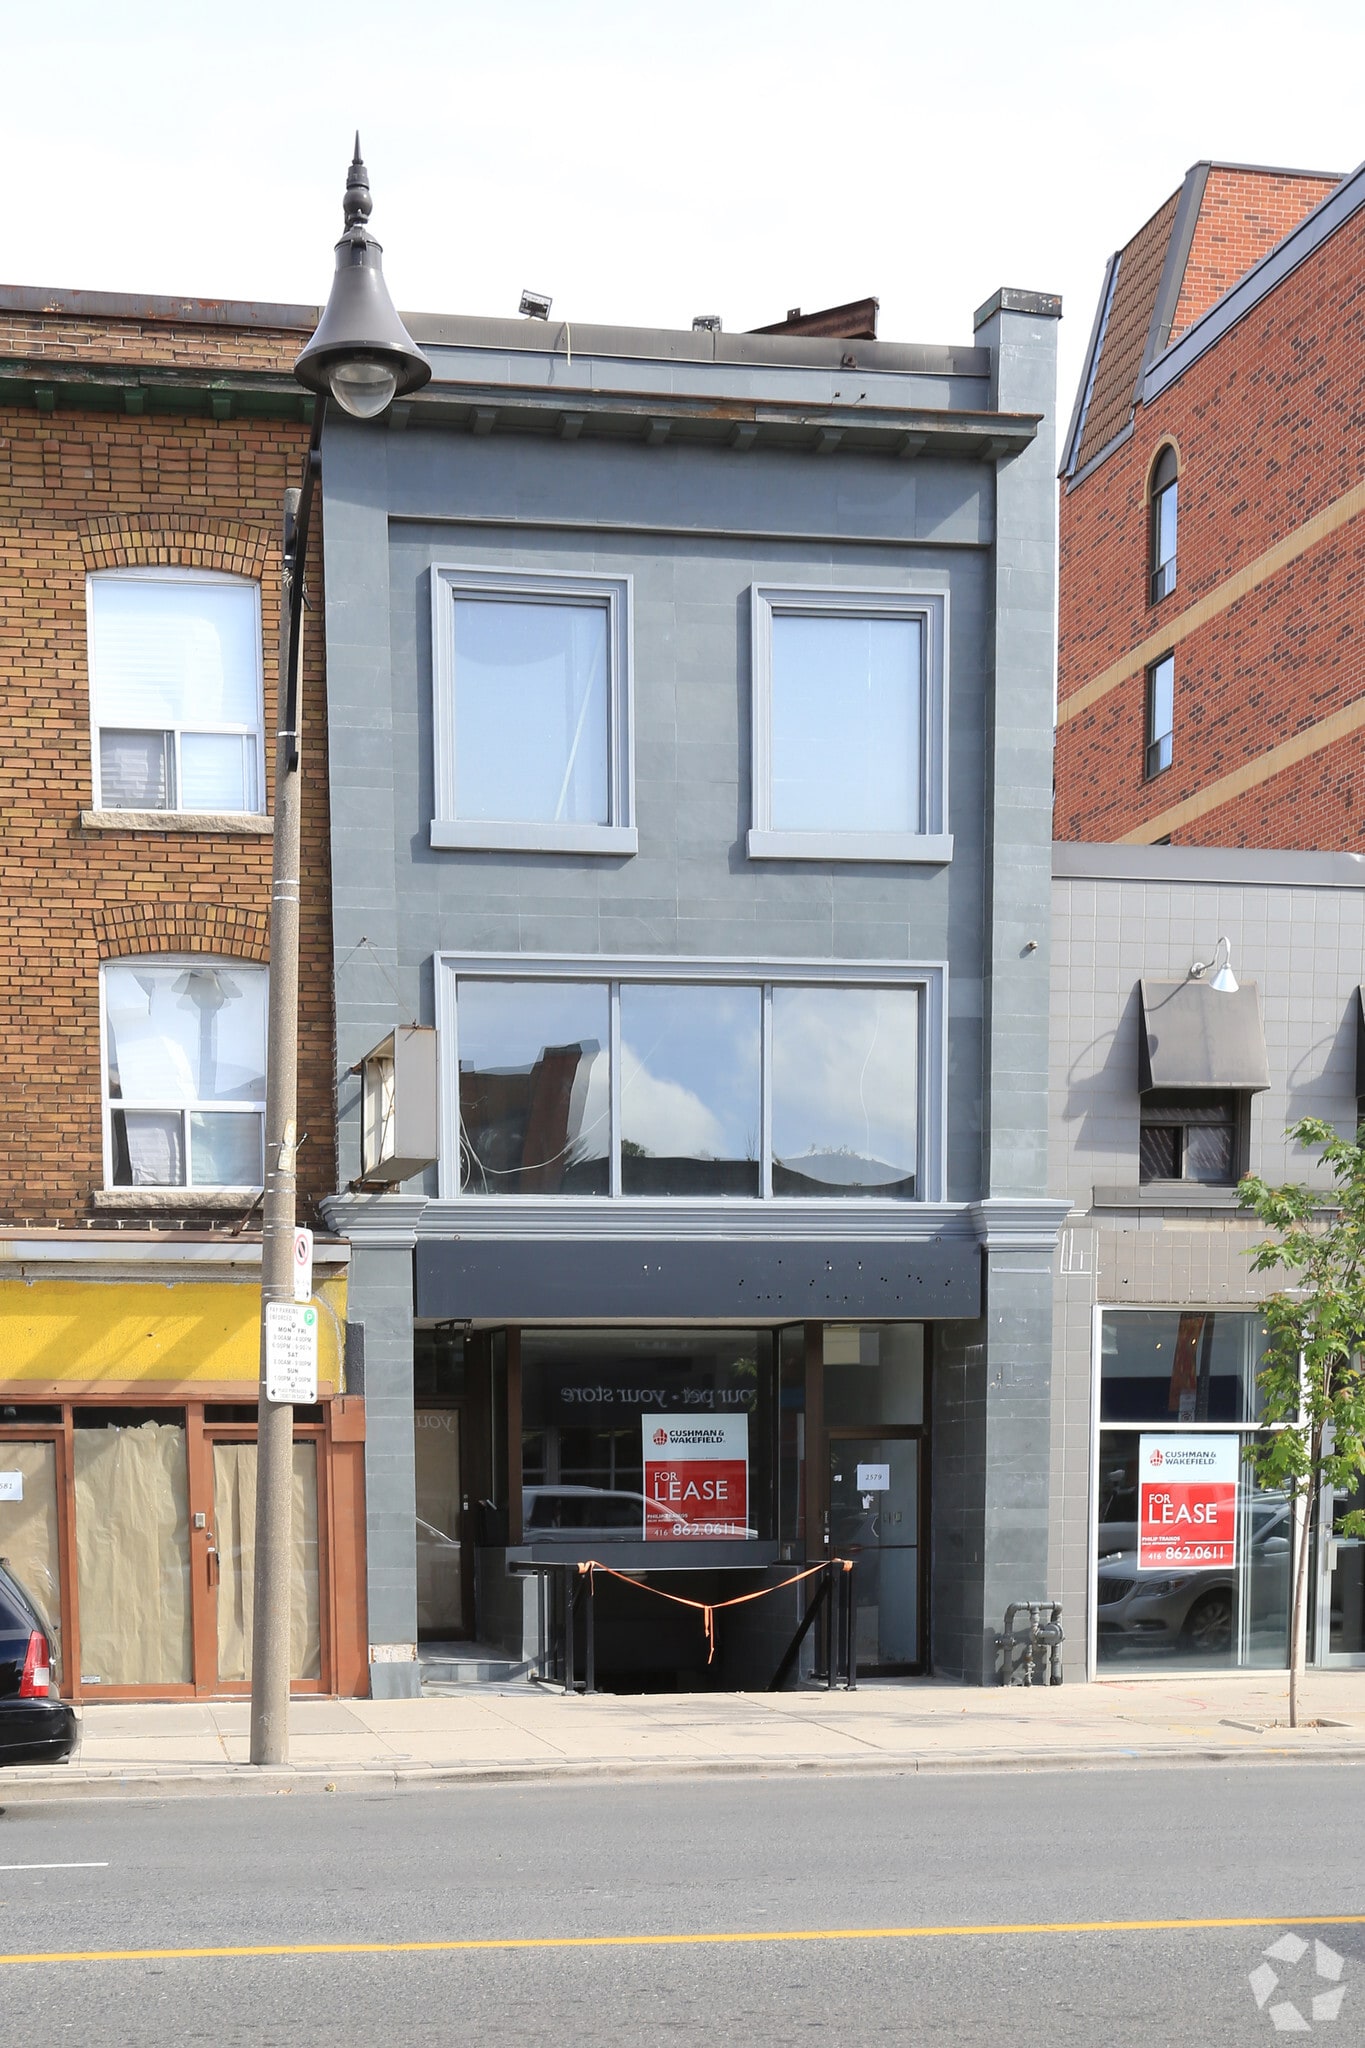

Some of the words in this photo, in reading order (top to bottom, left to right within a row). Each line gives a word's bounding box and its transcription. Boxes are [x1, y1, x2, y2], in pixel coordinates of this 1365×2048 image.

[654, 1471, 678, 1482] FOR
[654, 1480, 729, 1501] LEASE
[1149, 1493, 1171, 1504] FOR
[1149, 1503, 1218, 1524] LEASE
[672, 1522, 735, 1536] 862.0611
[1165, 1546, 1224, 1560] 862.0611
